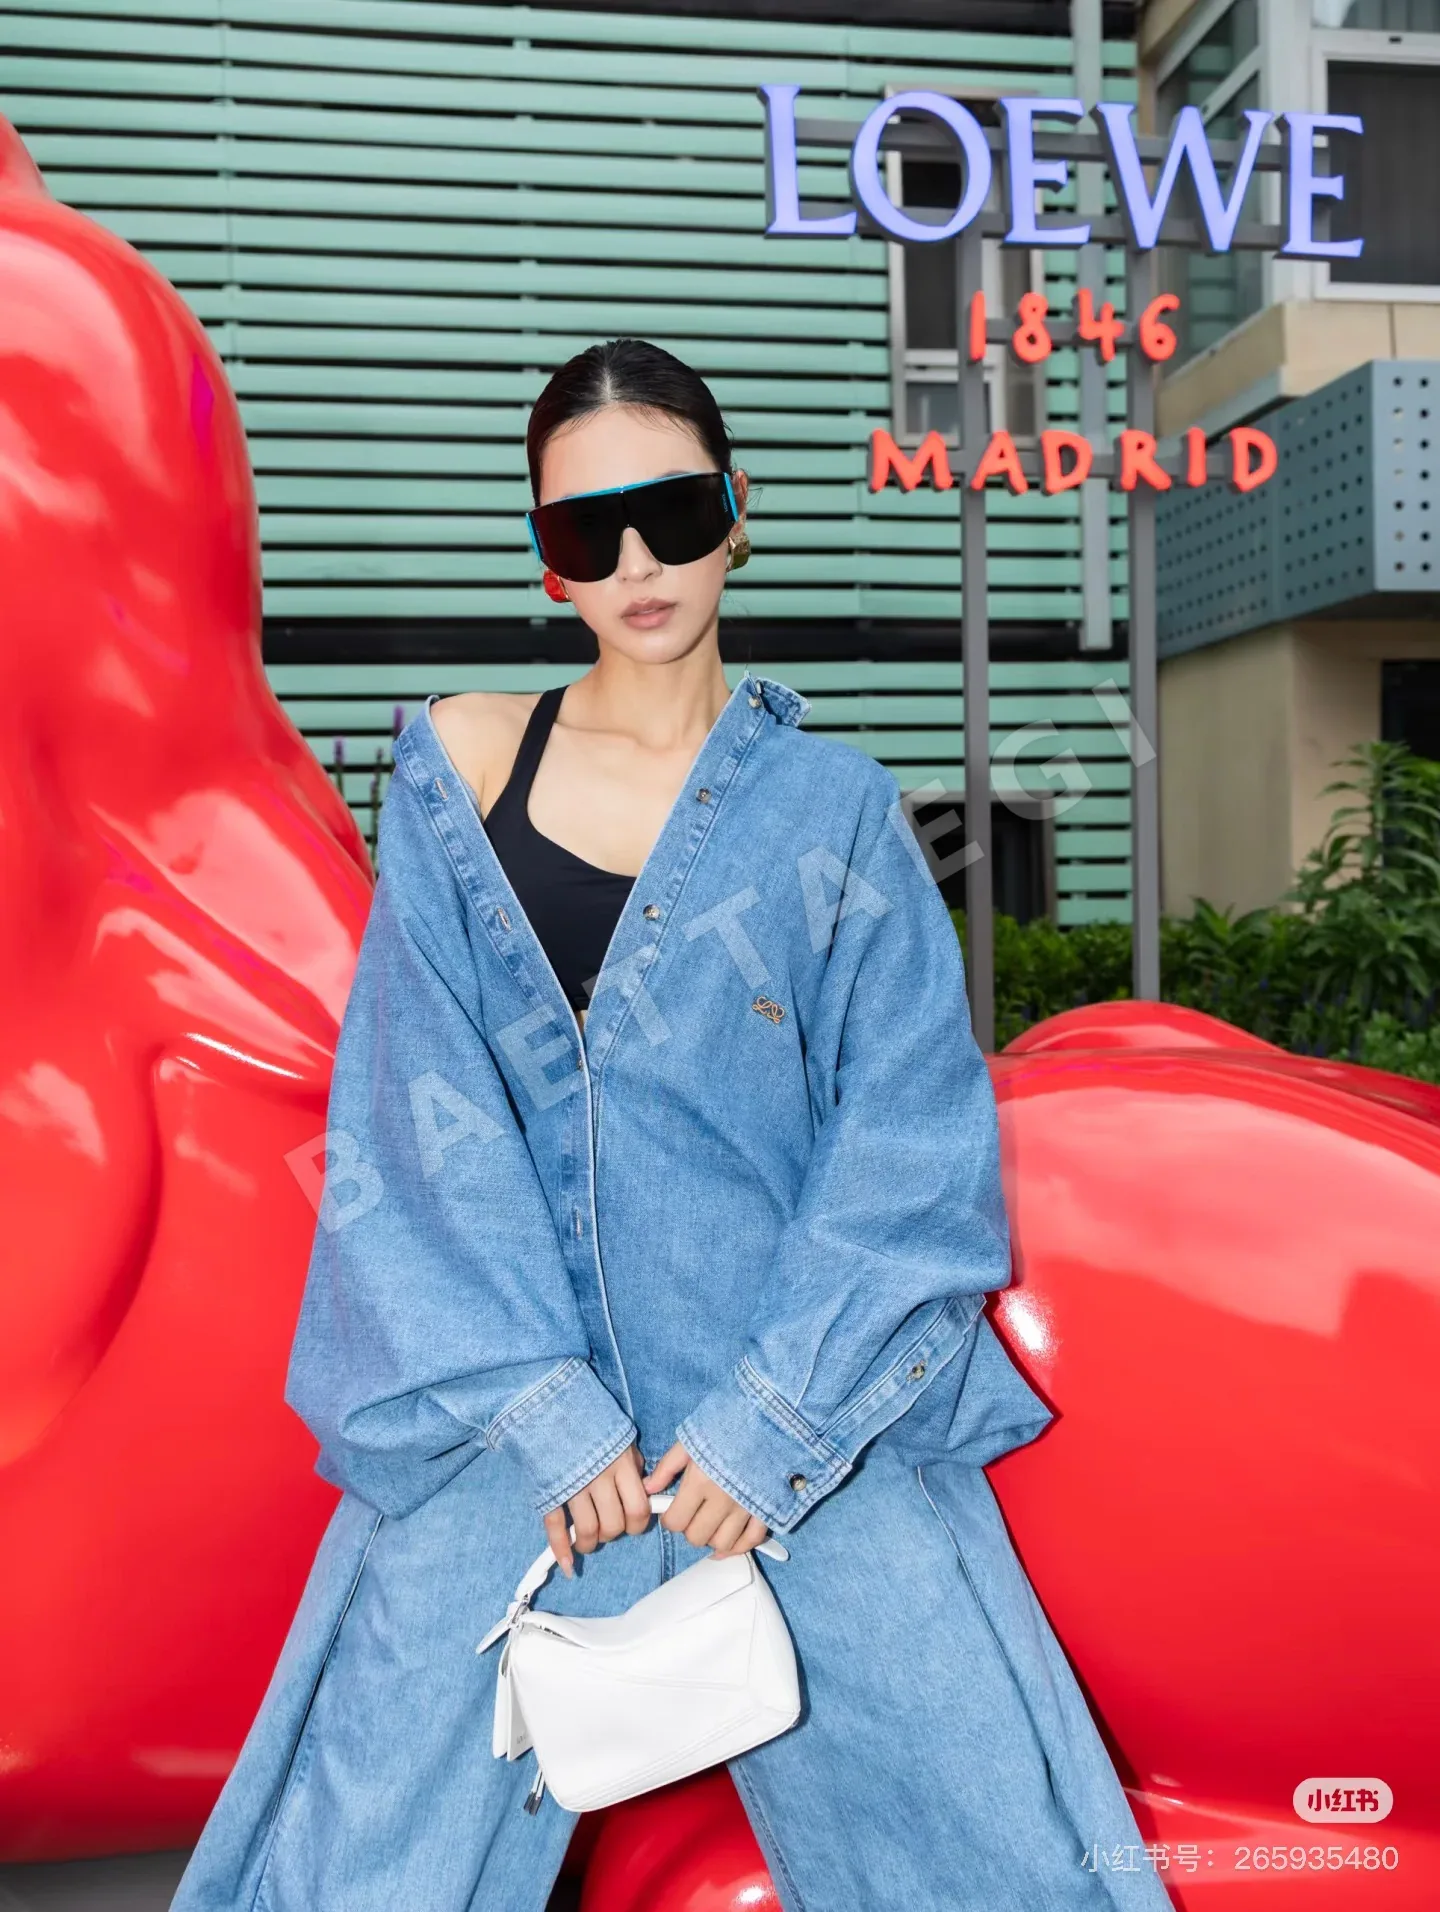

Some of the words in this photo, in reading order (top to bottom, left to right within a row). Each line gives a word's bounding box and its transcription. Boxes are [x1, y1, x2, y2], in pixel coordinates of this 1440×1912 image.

[759, 84, 1364, 257] LOEWE
[969, 288, 1181, 363] 1846
[867, 426, 1278, 494] MADRID
